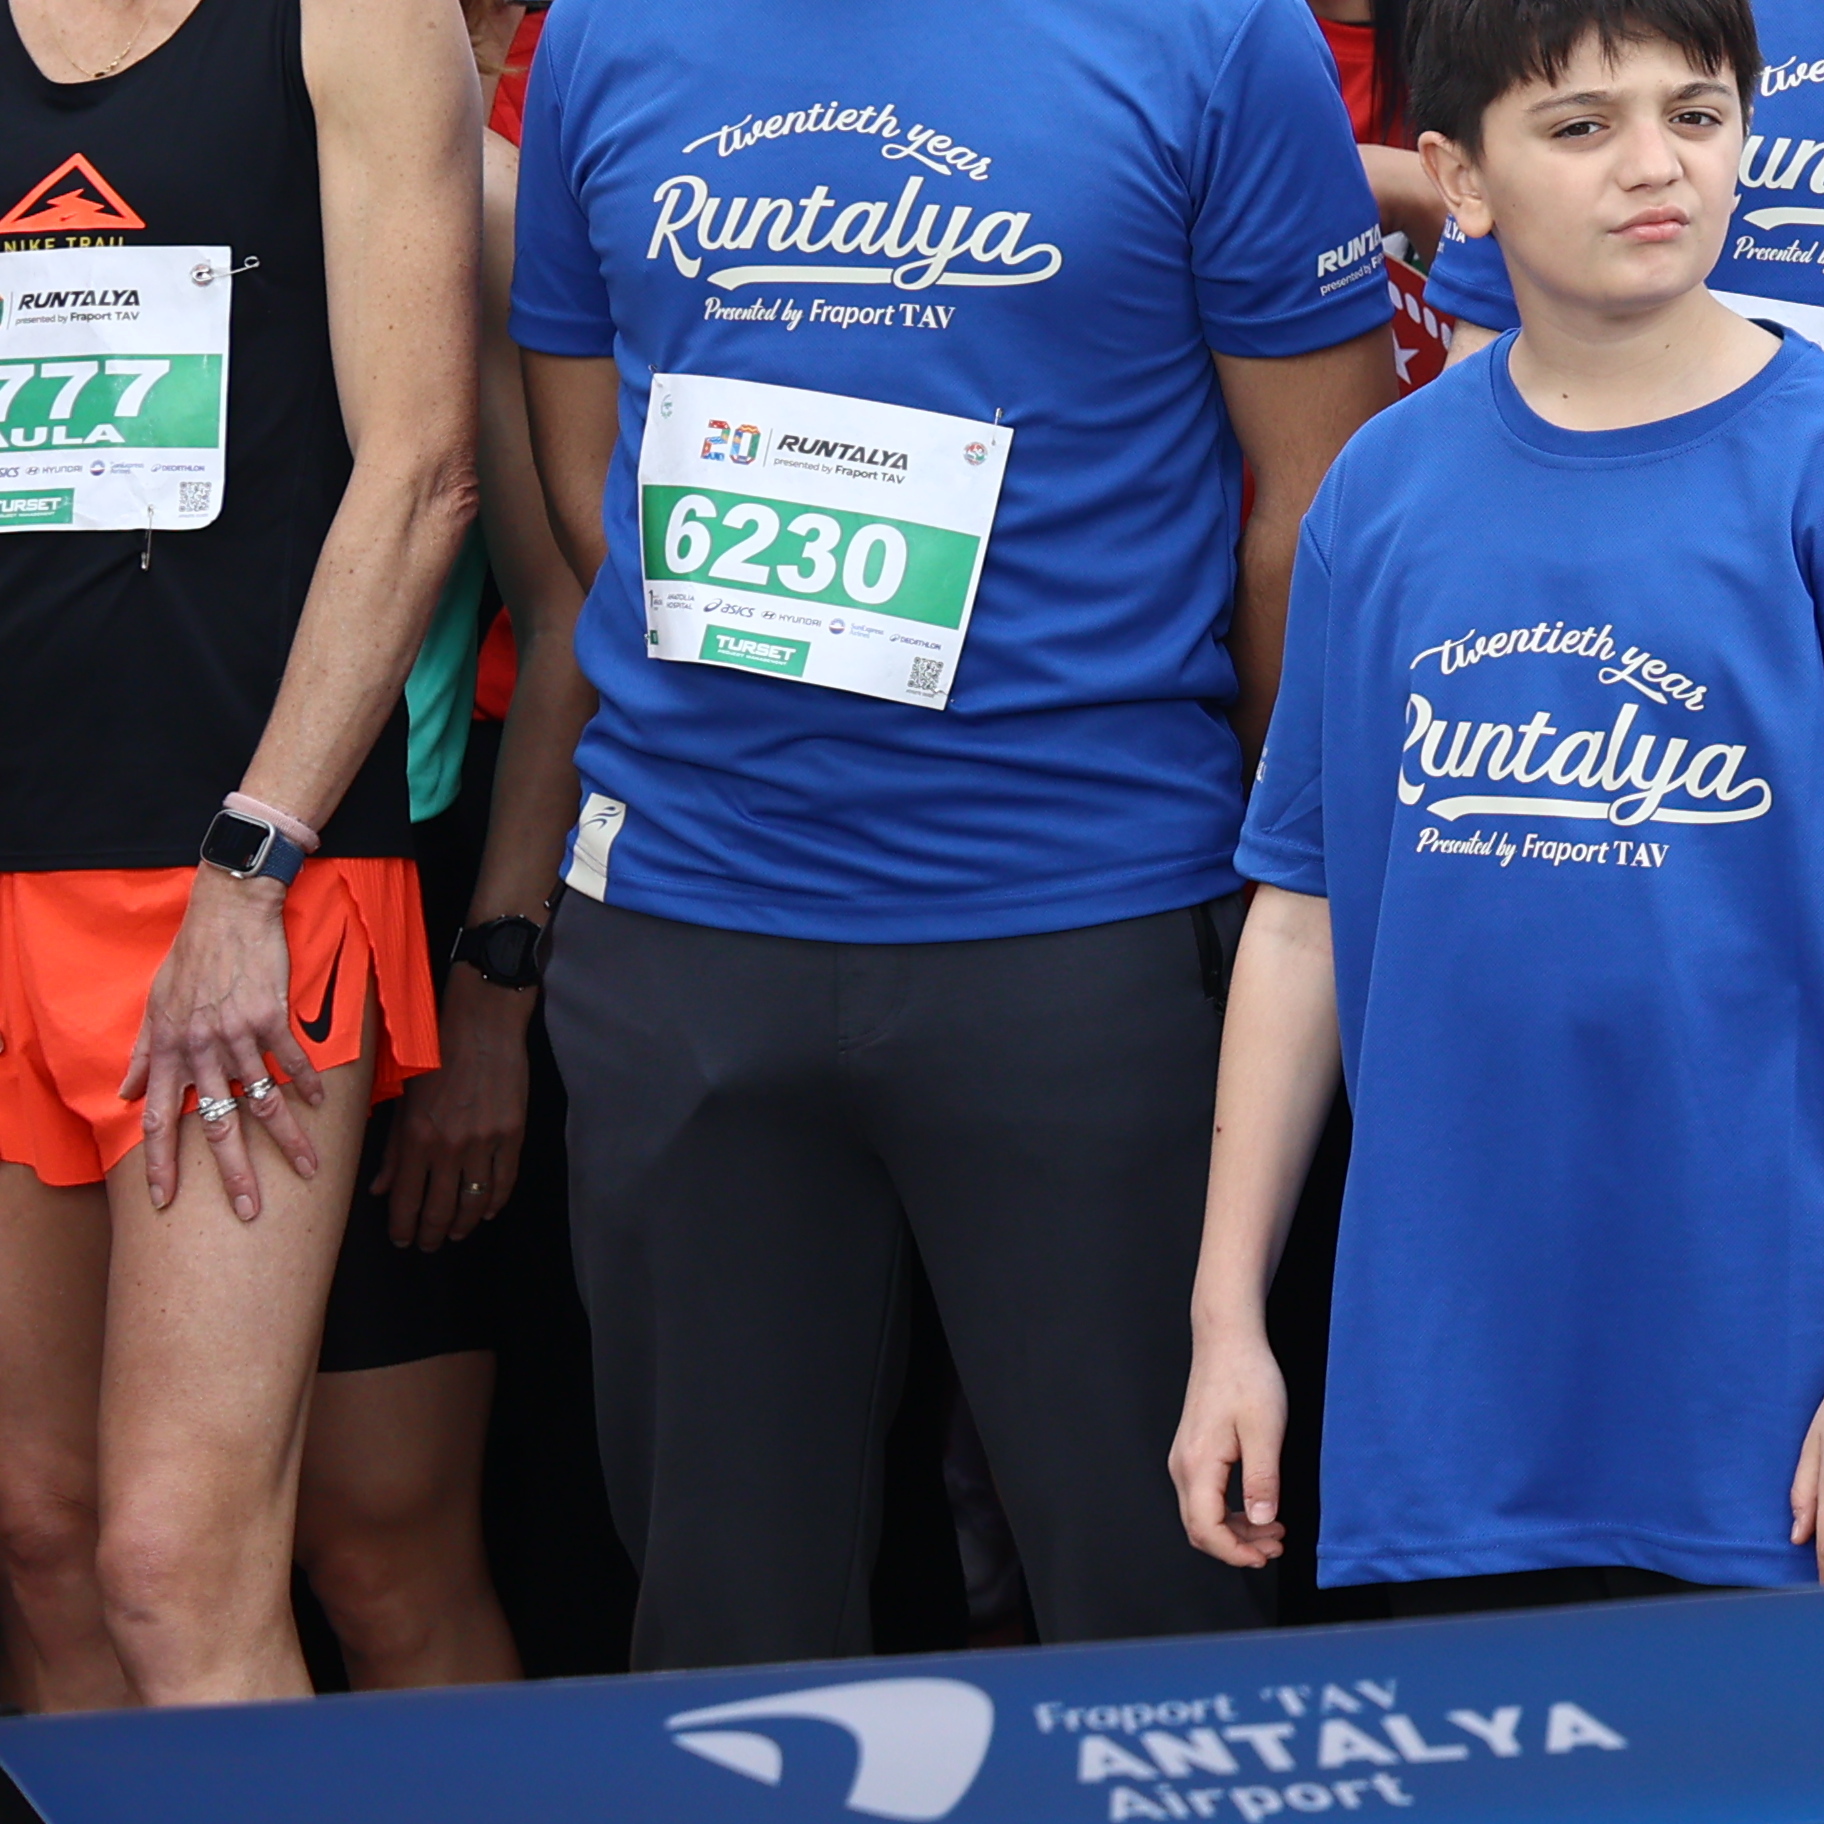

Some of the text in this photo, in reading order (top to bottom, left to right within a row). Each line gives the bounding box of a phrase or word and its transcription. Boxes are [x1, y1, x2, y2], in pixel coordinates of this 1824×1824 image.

[881, 122, 991, 181] year
[647, 175, 1063, 290] Runtalya
[1733, 236, 1812, 264] Presented
[18, 290, 141, 311] RUNTALYA
[70, 311, 141, 323] Fraport TAV
[704, 296, 955, 331] Presented by Fraport TAV
[0, 359, 171, 423] 777
[0, 423, 125, 448] ULA
[700, 419, 909, 471] 20 RUNTALYA
[773, 457, 905, 485] presented Fraport TAV
[664, 494, 907, 605] 6230
[716, 635, 796, 661] TURSET
[1599, 643, 1705, 711] year
[1416, 827, 1670, 868] Presented by Fraport TAV
[1034, 1678, 1398, 1738] Fraport TAV
[1077, 1700, 1627, 1784] ANTALYA
[1107, 1770, 1412, 1824] Airport
